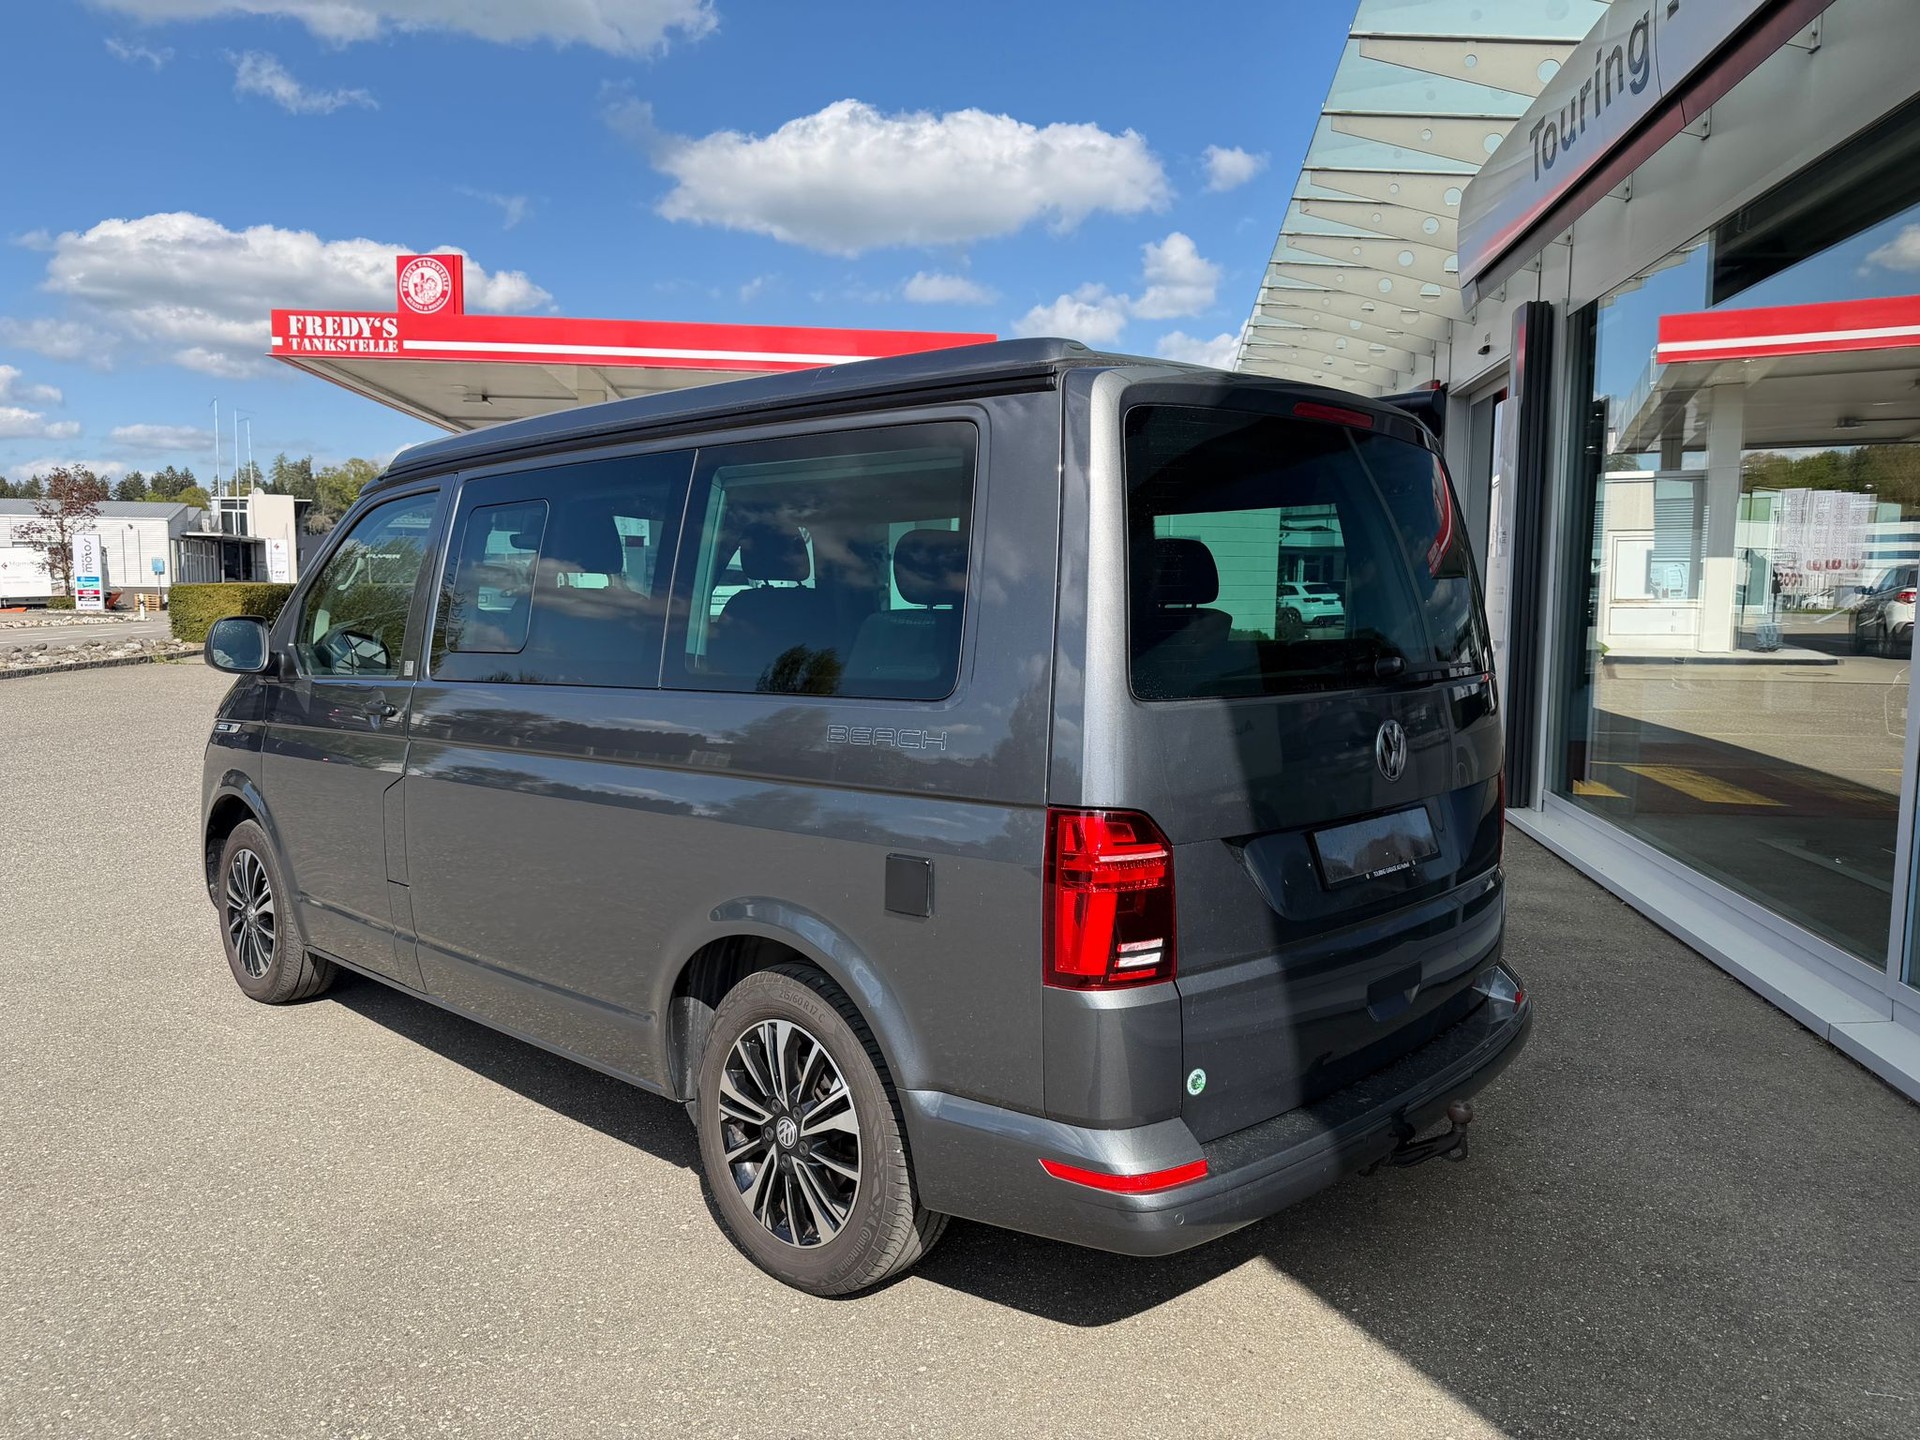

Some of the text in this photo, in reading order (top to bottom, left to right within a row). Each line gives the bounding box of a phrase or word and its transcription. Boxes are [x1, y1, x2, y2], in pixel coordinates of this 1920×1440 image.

[1529, 10, 1650, 183] Touring
[288, 314, 398, 339] FREDY'S
[288, 337, 399, 353] TANKSTELLE
[826, 724, 947, 751] BEACH
